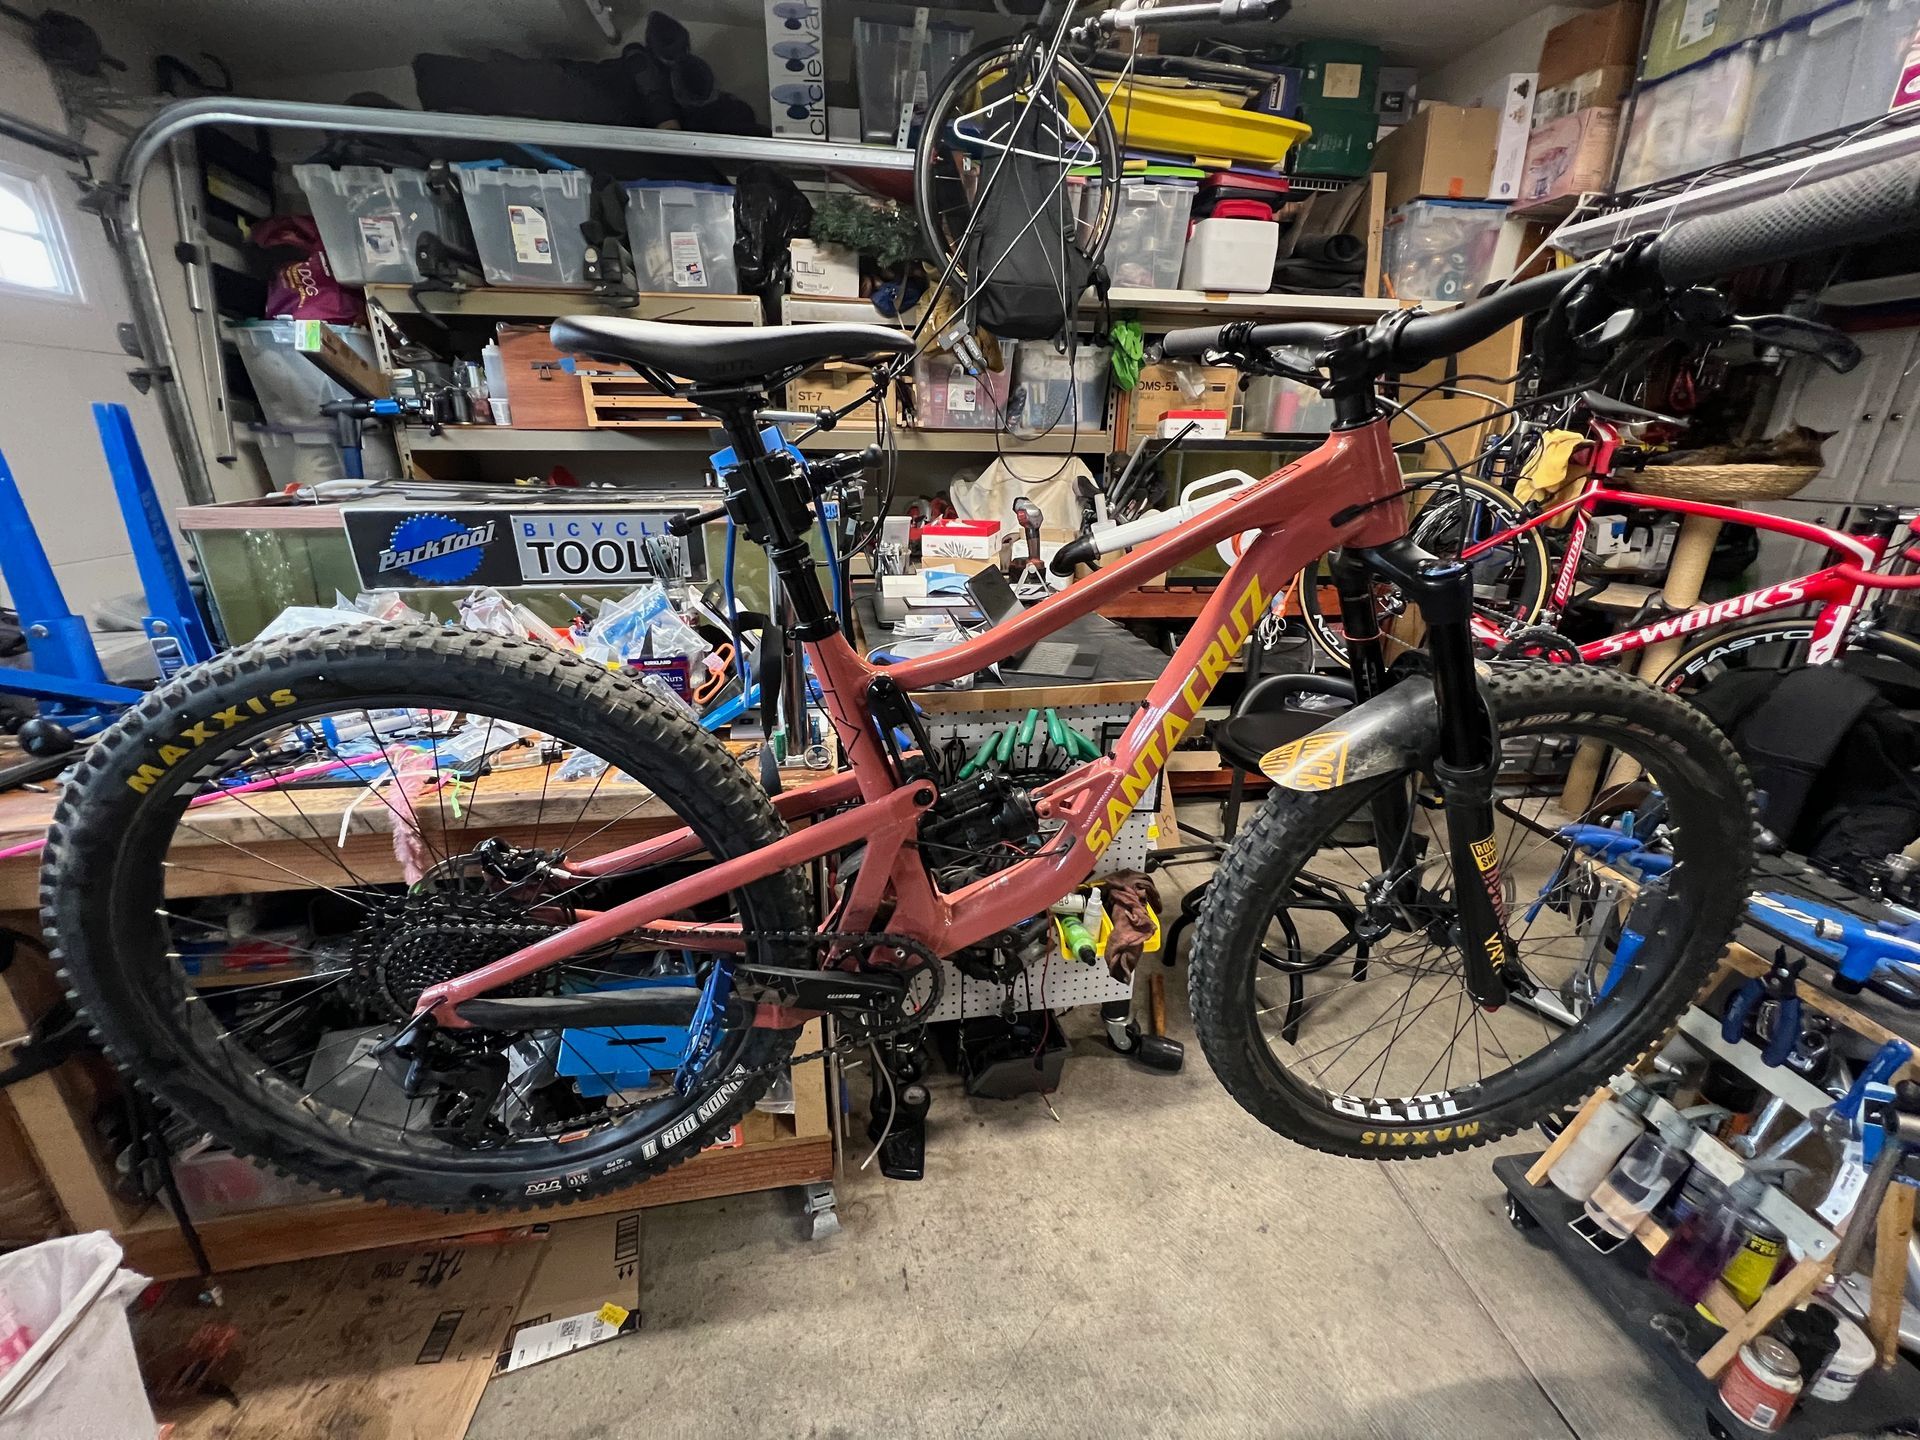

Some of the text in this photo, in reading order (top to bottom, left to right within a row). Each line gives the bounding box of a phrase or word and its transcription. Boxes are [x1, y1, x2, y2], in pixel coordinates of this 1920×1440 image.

[798, 391, 823, 401] ST-7
[378, 519, 497, 573] ParkTool
[526, 539, 656, 577] TOOL
[1555, 527, 1584, 601] SPECIALIZED
[1600, 581, 1806, 657] S-WORKS
[1685, 629, 1814, 676] EASTO
[1085, 709, 1190, 861] SANTA
[1182, 573, 1273, 714] CRUZ
[126, 688, 298, 795] MAXXIS
[1295, 737, 1338, 789] ROCK
[1474, 835, 1497, 857] ROC
[1480, 853, 1498, 868] SHO
[661, 1112, 700, 1150] DHR
[1360, 1121, 1480, 1146] MAXXIS
